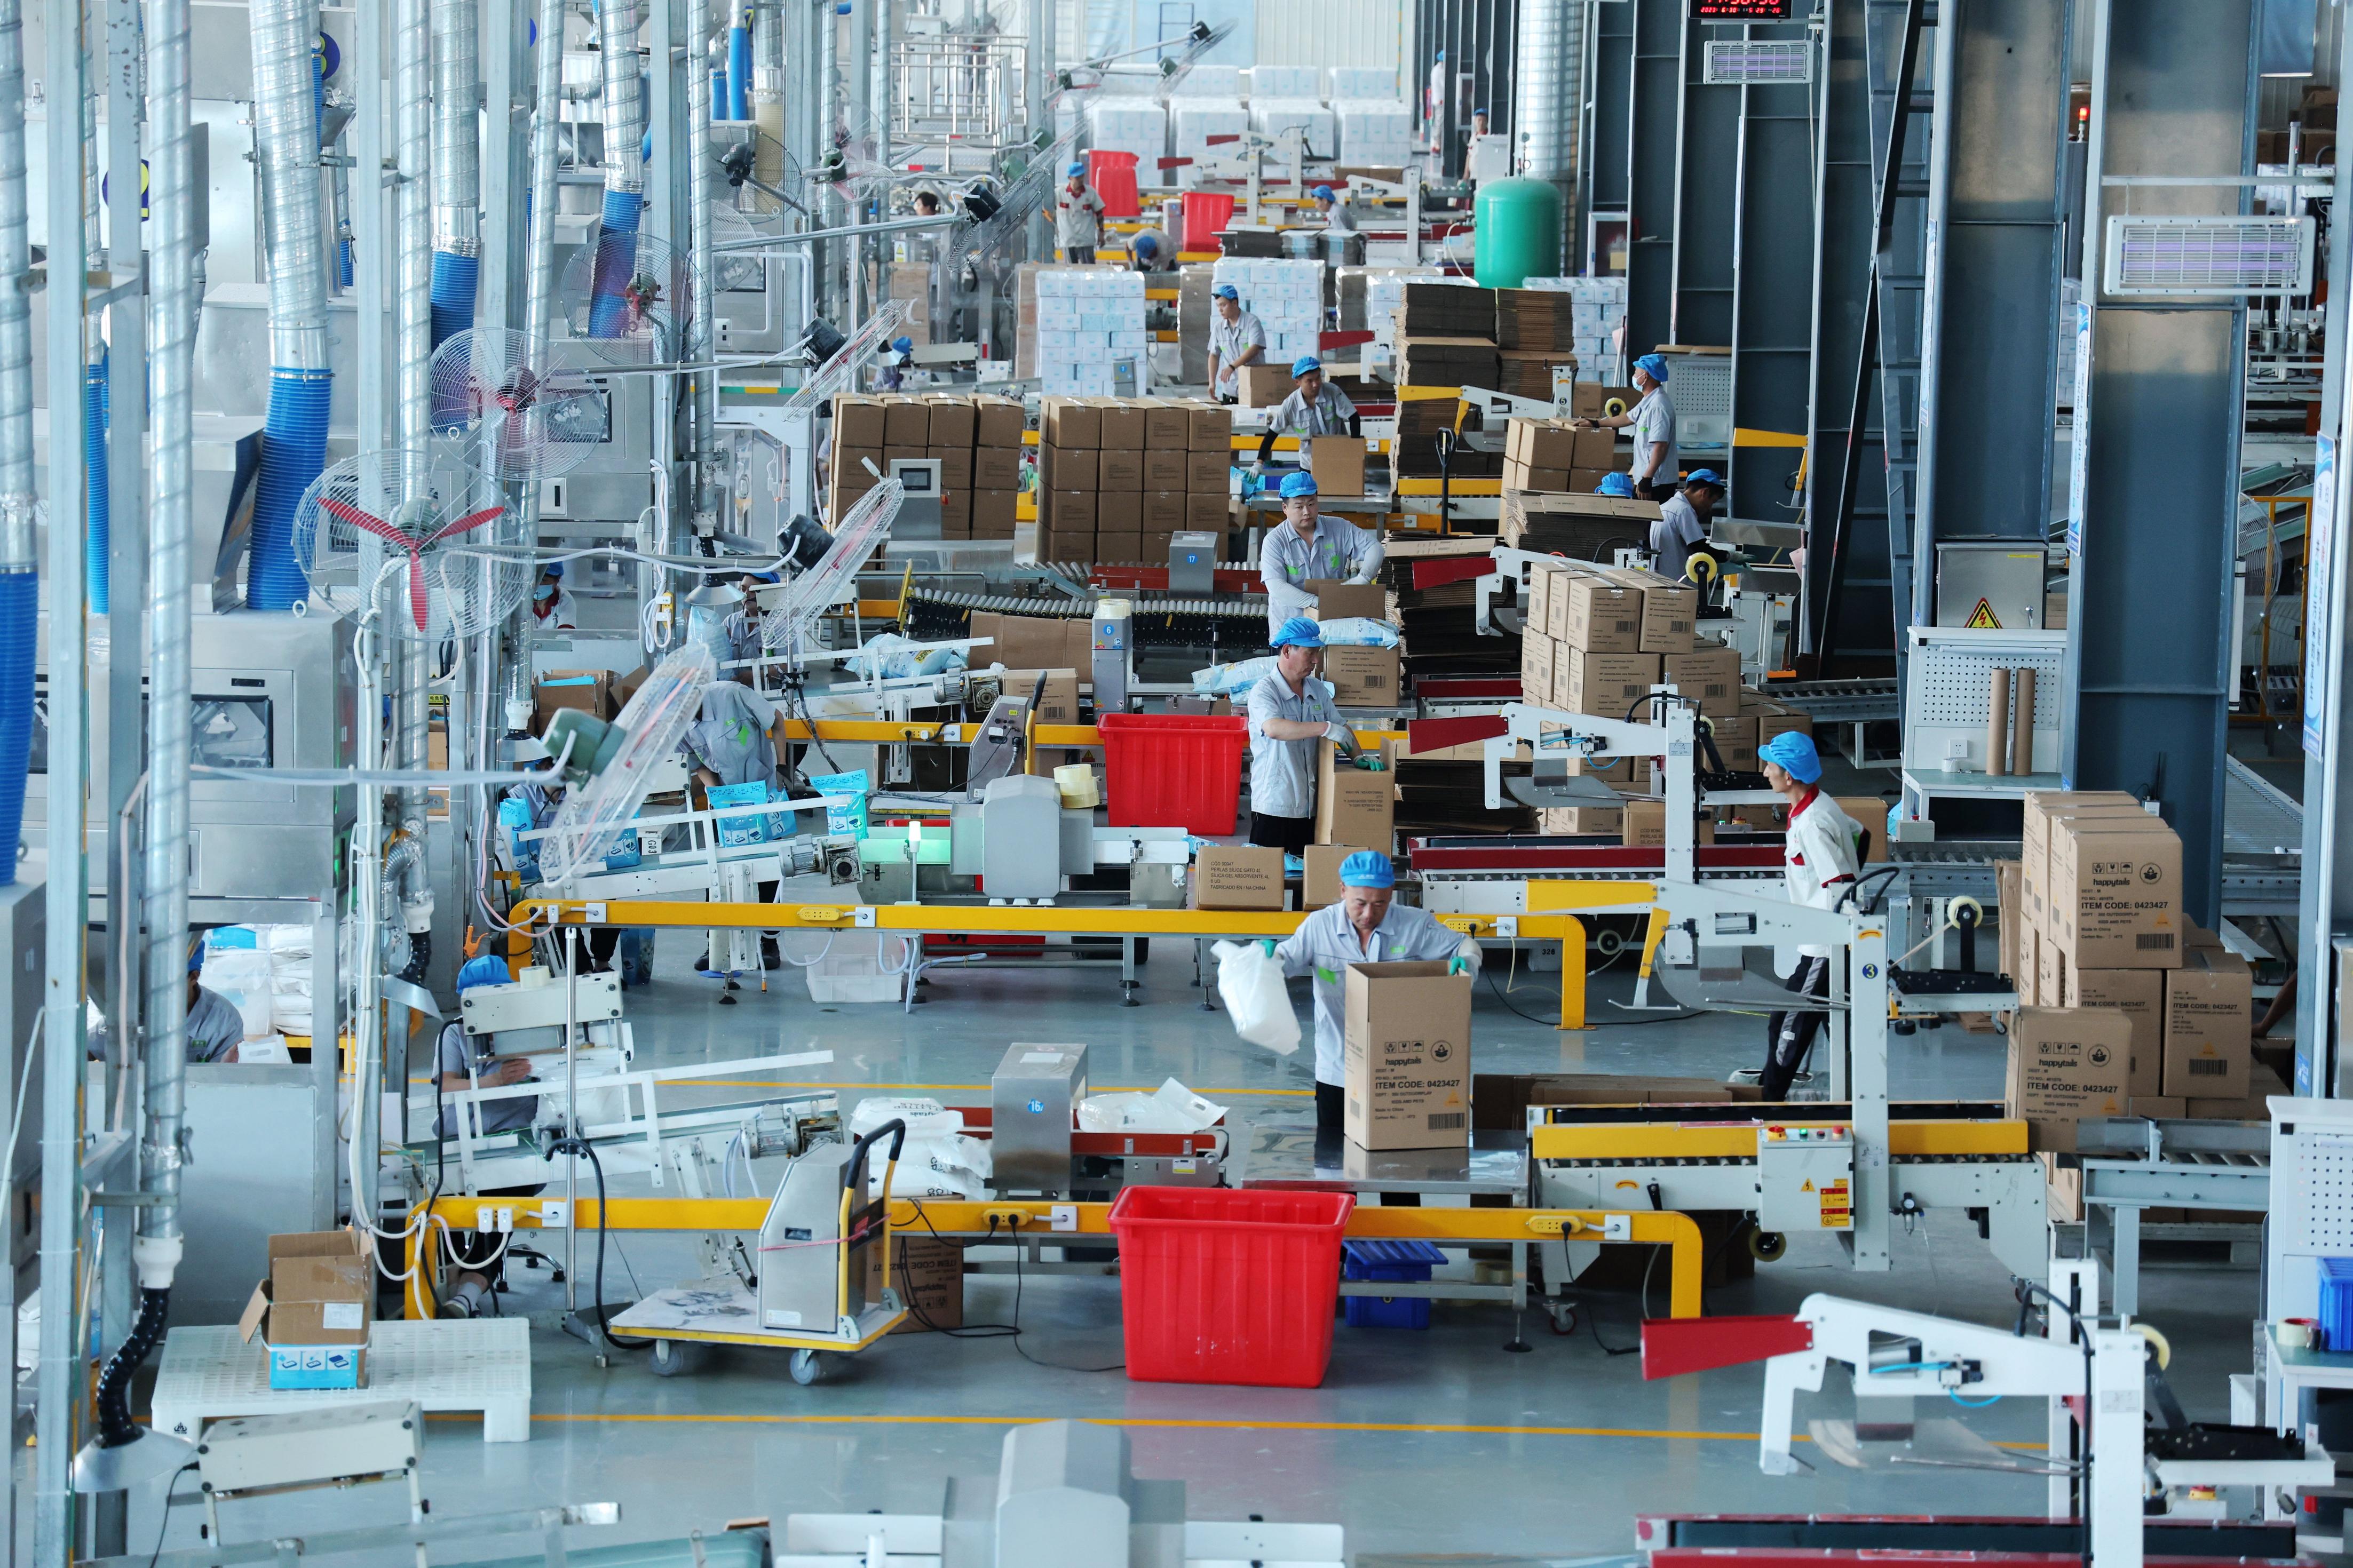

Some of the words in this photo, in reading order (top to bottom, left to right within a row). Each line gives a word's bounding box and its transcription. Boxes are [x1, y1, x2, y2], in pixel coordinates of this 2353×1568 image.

[2093, 878, 2130, 887] happytails
[1866, 964, 1875, 978] 3
[1385, 1056, 1422, 1066] happytails
[2039, 1058, 2077, 1068] happytails
[2051, 1084, 2080, 1092] CODE:
[1031, 1101, 1041, 1112] 16
